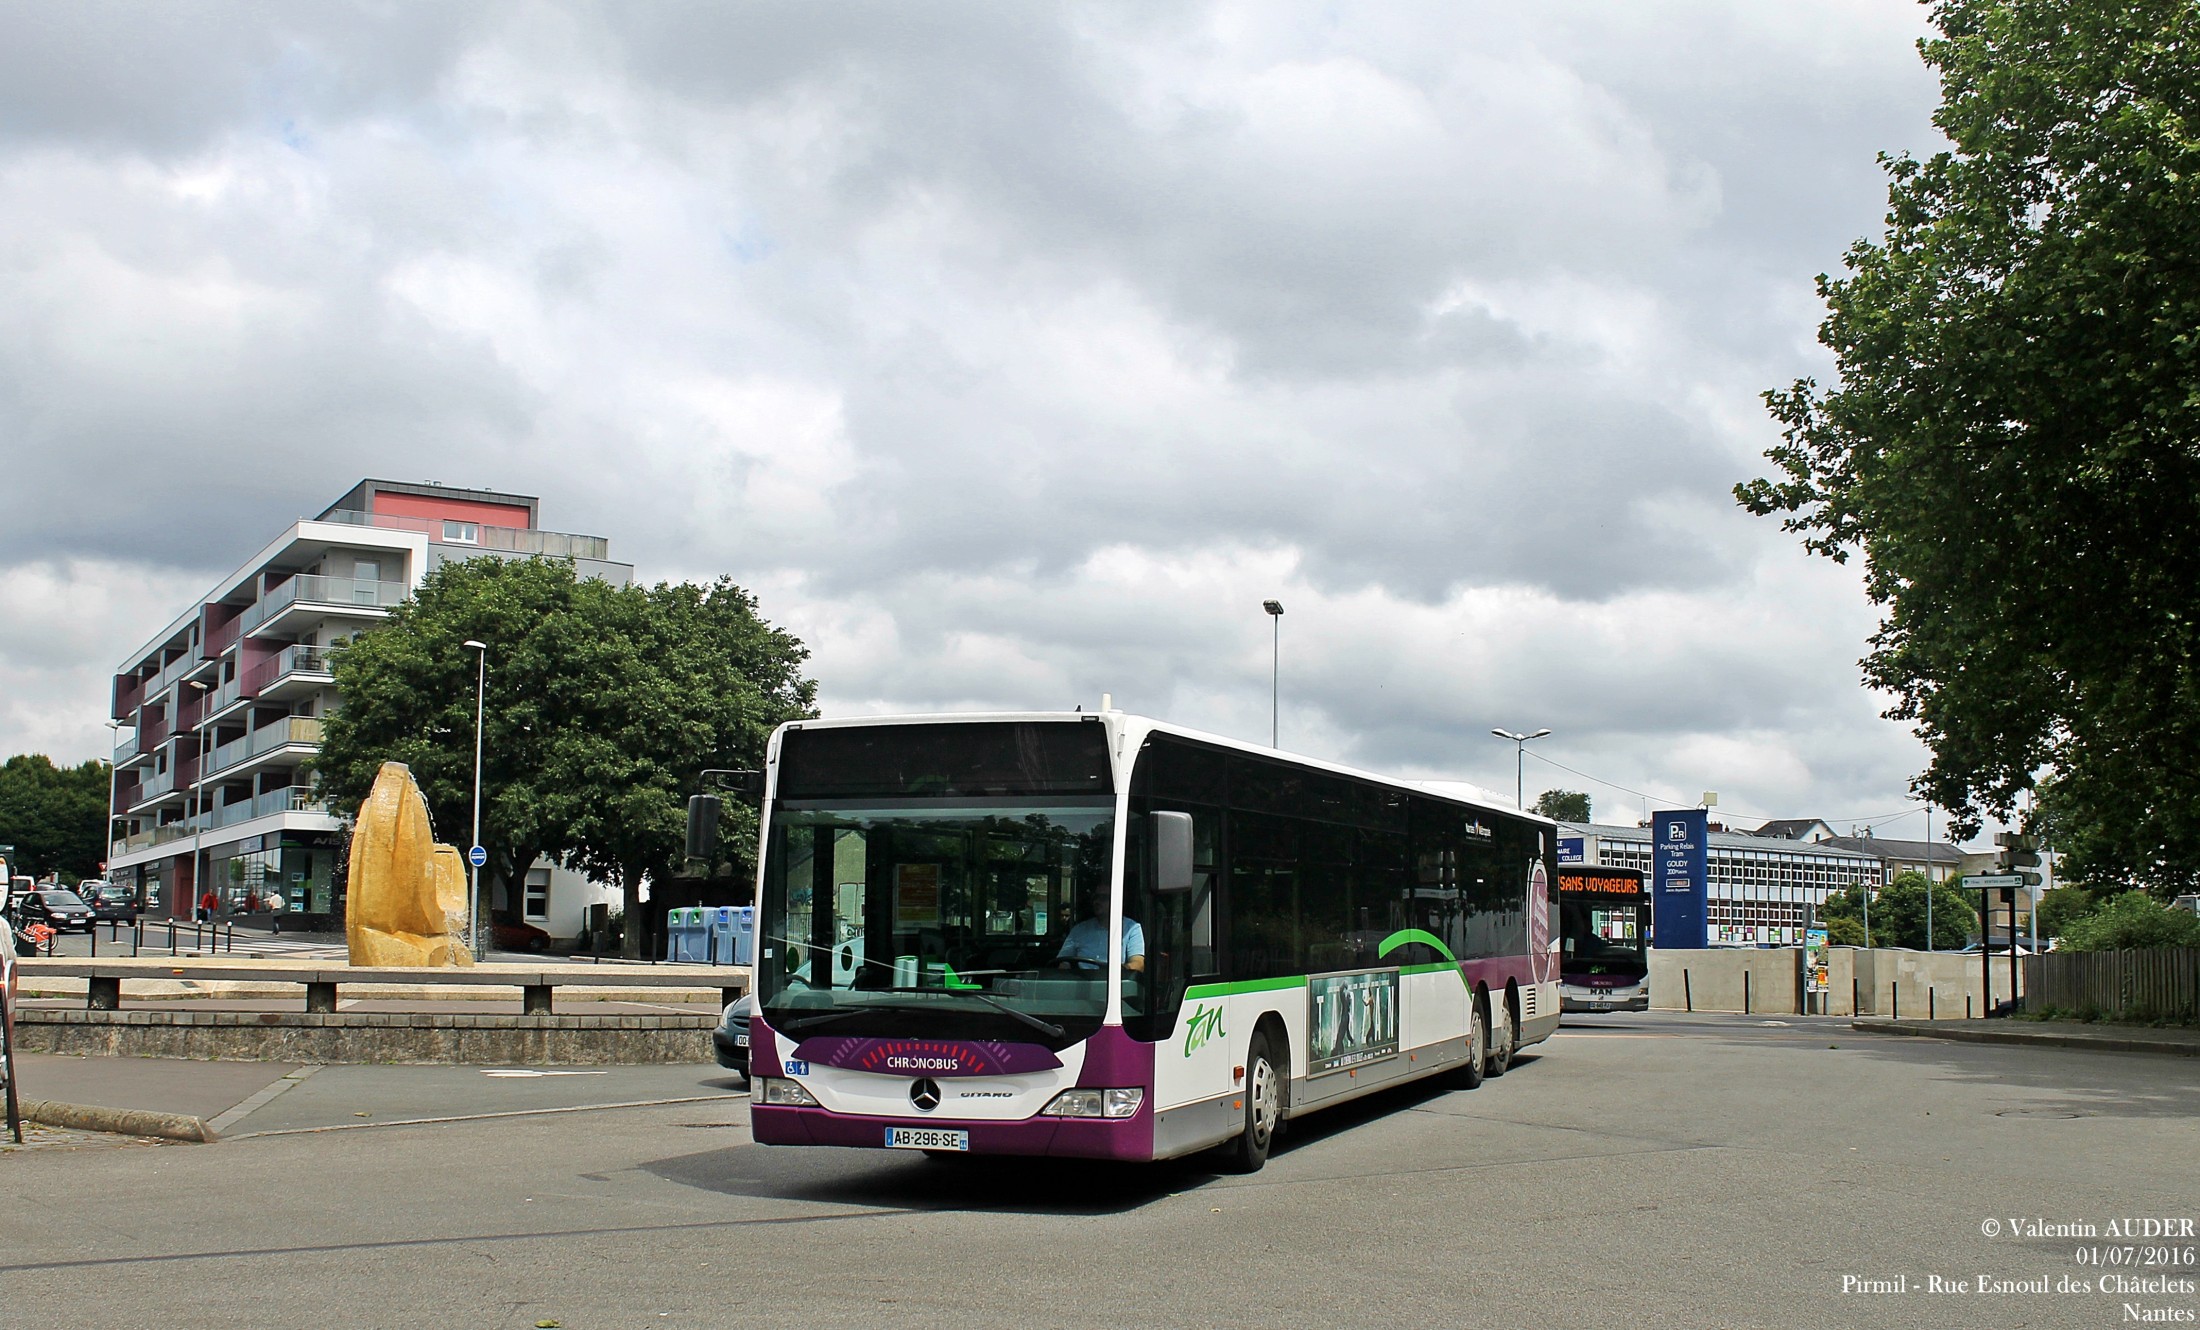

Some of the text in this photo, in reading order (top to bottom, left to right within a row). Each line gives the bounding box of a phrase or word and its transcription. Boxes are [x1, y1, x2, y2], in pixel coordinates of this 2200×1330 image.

[1559, 876, 1638, 894] SANS VOYAGEURS
[1590, 988, 1613, 996] MAN
[1184, 1003, 1226, 1058] tan
[887, 1056, 958, 1071] CHRONOBUS
[894, 1131, 959, 1147] AB-296-SE
